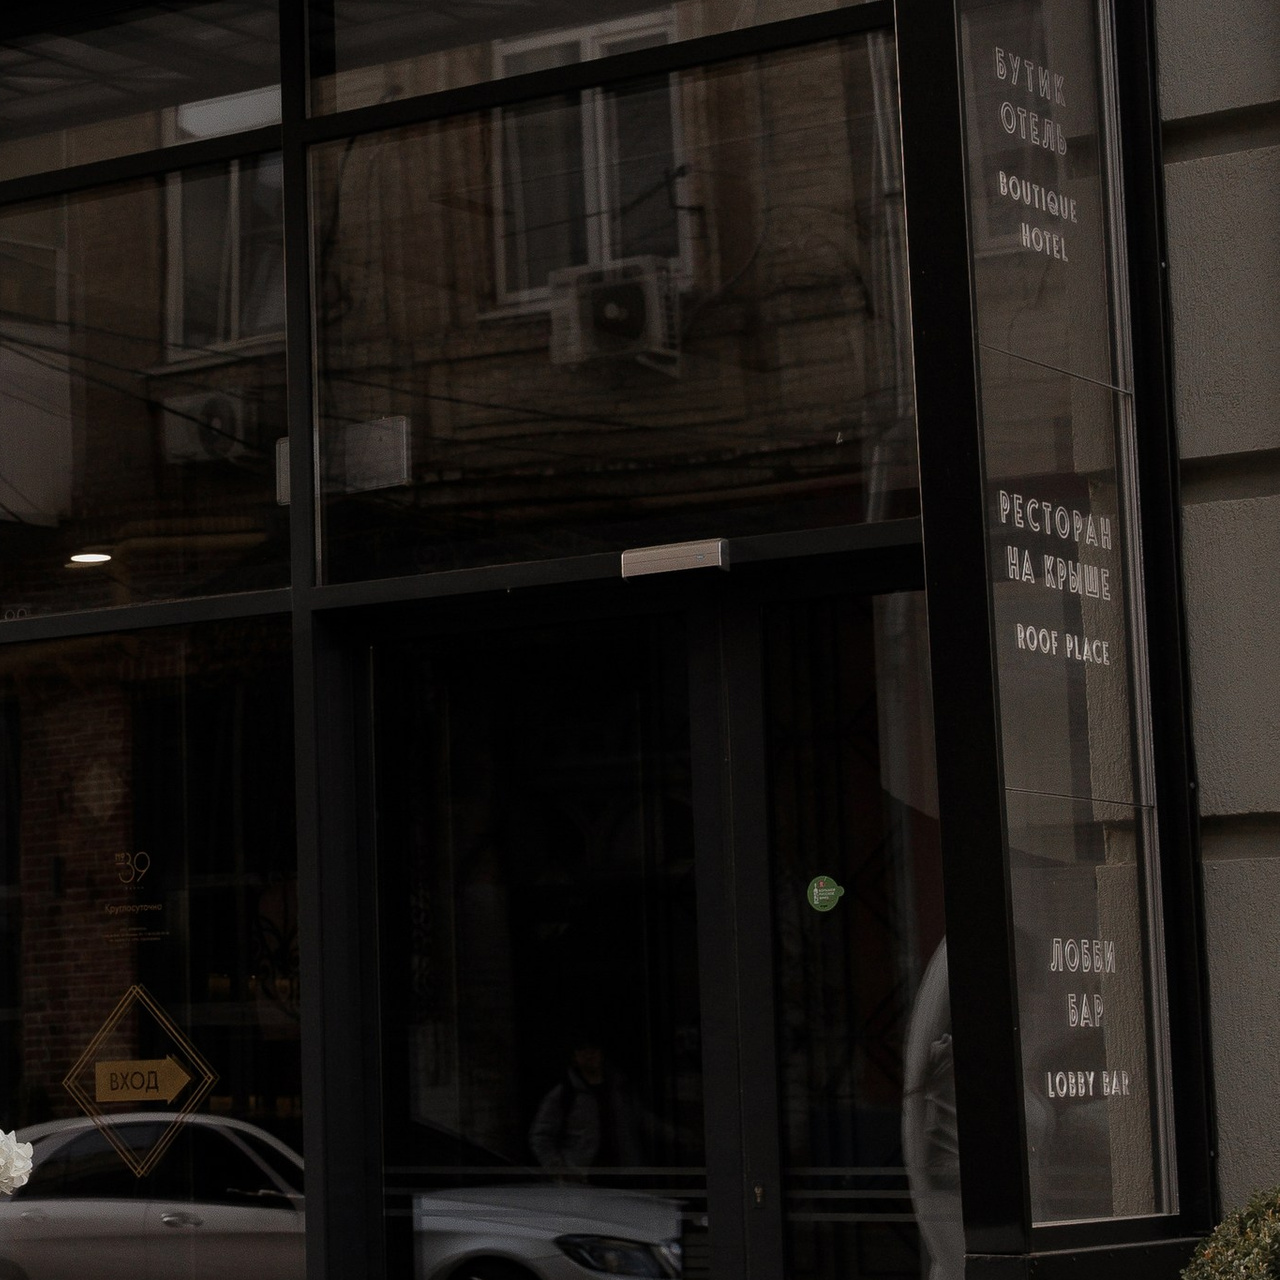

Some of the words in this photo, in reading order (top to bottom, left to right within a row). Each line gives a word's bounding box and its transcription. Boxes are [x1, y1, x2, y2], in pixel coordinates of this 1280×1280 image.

[995, 47, 1067, 107] БУТИК
[1000, 101, 1068, 157] ОТЕЛЬ
[998, 171, 1078, 224] BOUTIQUE
[1021, 221, 1069, 263] HOTEL
[998, 490, 1113, 550] РЕСТОРАН
[1006, 546, 1035, 585] НА
[1044, 555, 1111, 601] КРЫШЕ
[1016, 624, 1058, 655] ROOF
[1066, 634, 1110, 665] PLACE
[1050, 937, 1116, 974] ЛОББИ
[1067, 993, 1103, 1028] БАР
[110, 1068, 160, 1092] ВХОД
[1047, 1071, 1094, 1099] LOBBY
[1102, 1071, 1130, 1097] BAR
